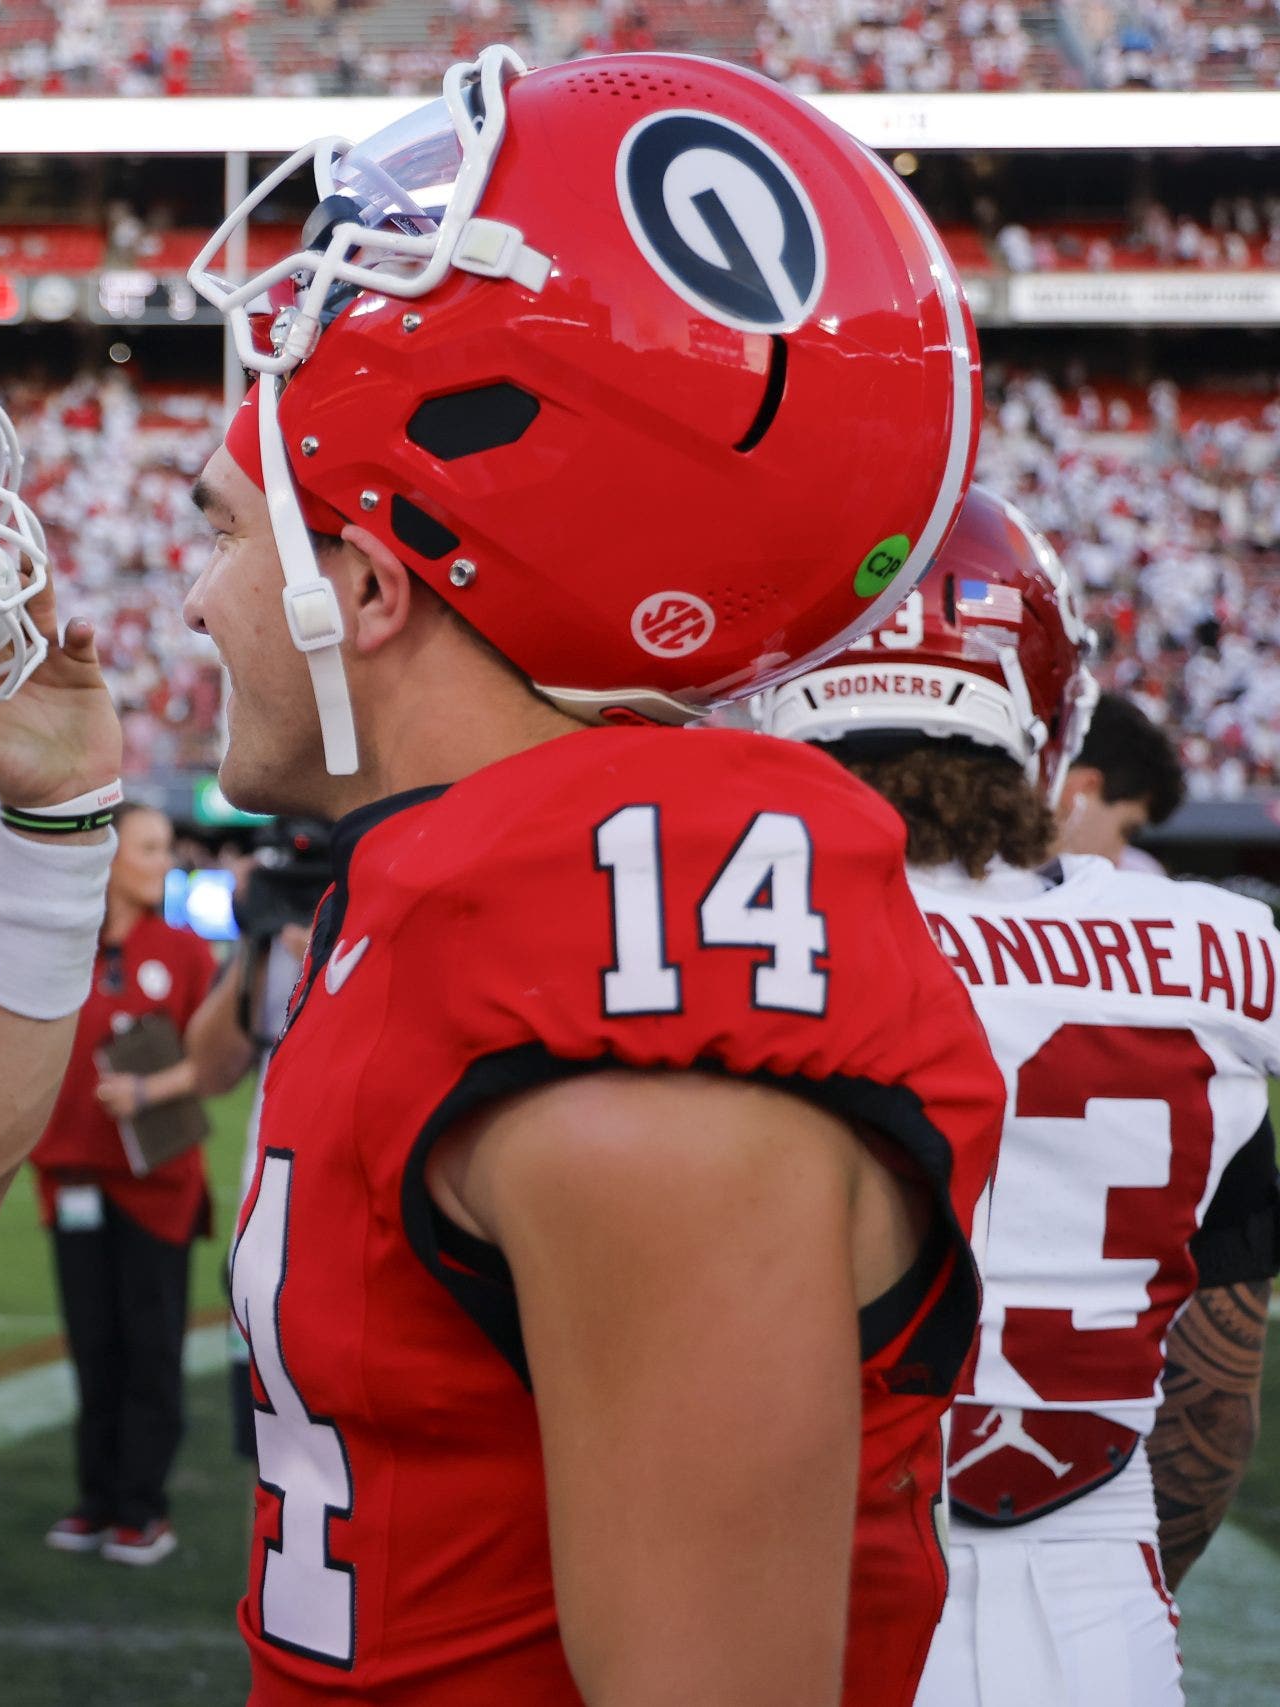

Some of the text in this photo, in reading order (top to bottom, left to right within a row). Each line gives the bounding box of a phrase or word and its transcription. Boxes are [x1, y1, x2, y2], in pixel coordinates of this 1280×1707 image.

[615, 109, 827, 334] G
[640, 600, 706, 650] SEC
[823, 674, 942, 700] SOONERS
[593, 803, 830, 1018] 14
[924, 912, 1275, 1022] ANDREAU
